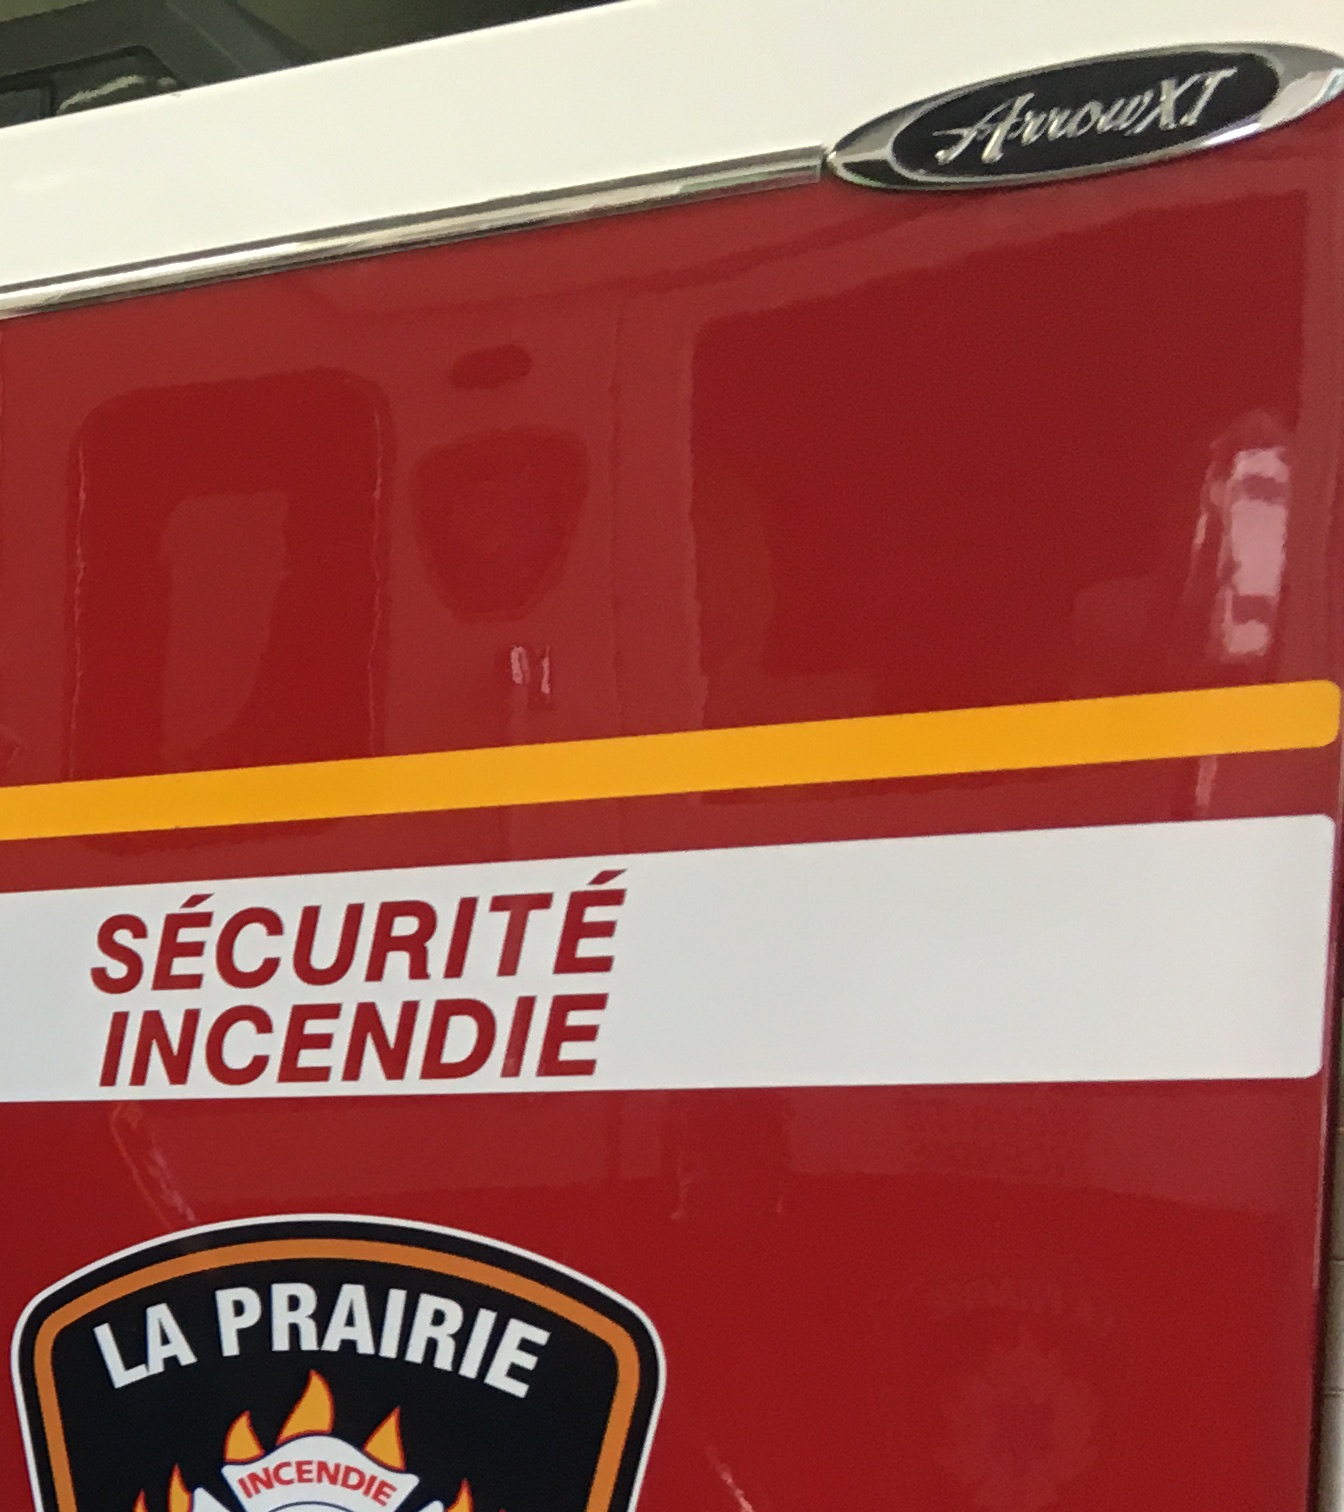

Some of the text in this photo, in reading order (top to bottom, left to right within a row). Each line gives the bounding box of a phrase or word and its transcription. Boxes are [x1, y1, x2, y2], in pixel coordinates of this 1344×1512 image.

[90, 869, 627, 995] SÉCURITÉ
[99, 993, 609, 1087] INCENDIE
[93, 1283, 551, 1399] LA PRAIRIE
[237, 1460, 398, 1507] INCENDIE
